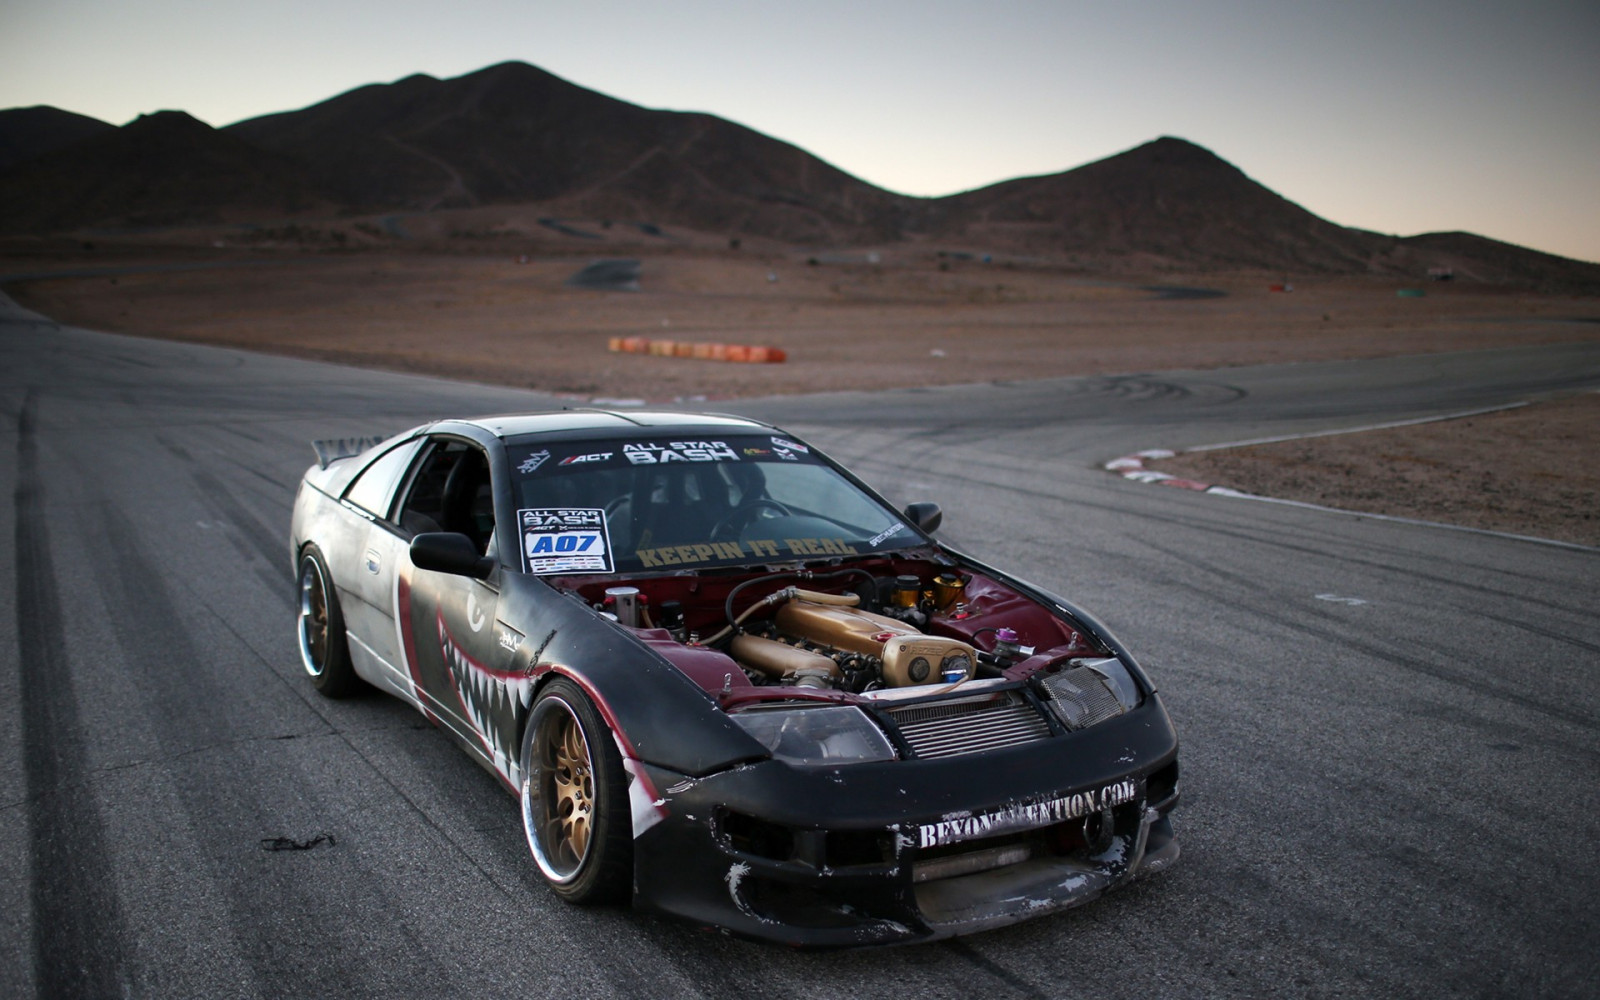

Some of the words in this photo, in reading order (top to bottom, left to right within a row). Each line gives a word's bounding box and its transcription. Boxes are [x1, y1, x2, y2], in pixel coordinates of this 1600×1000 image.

[623, 443, 665, 452] ALL
[669, 441, 730, 450] STAR
[570, 452, 614, 463] ACT
[624, 448, 741, 465] BASH
[524, 516, 600, 525] BASH
[531, 536, 597, 553] A07
[636, 541, 746, 568] KEEPIN
[747, 539, 780, 557] IT
[783, 538, 858, 556] REAL
